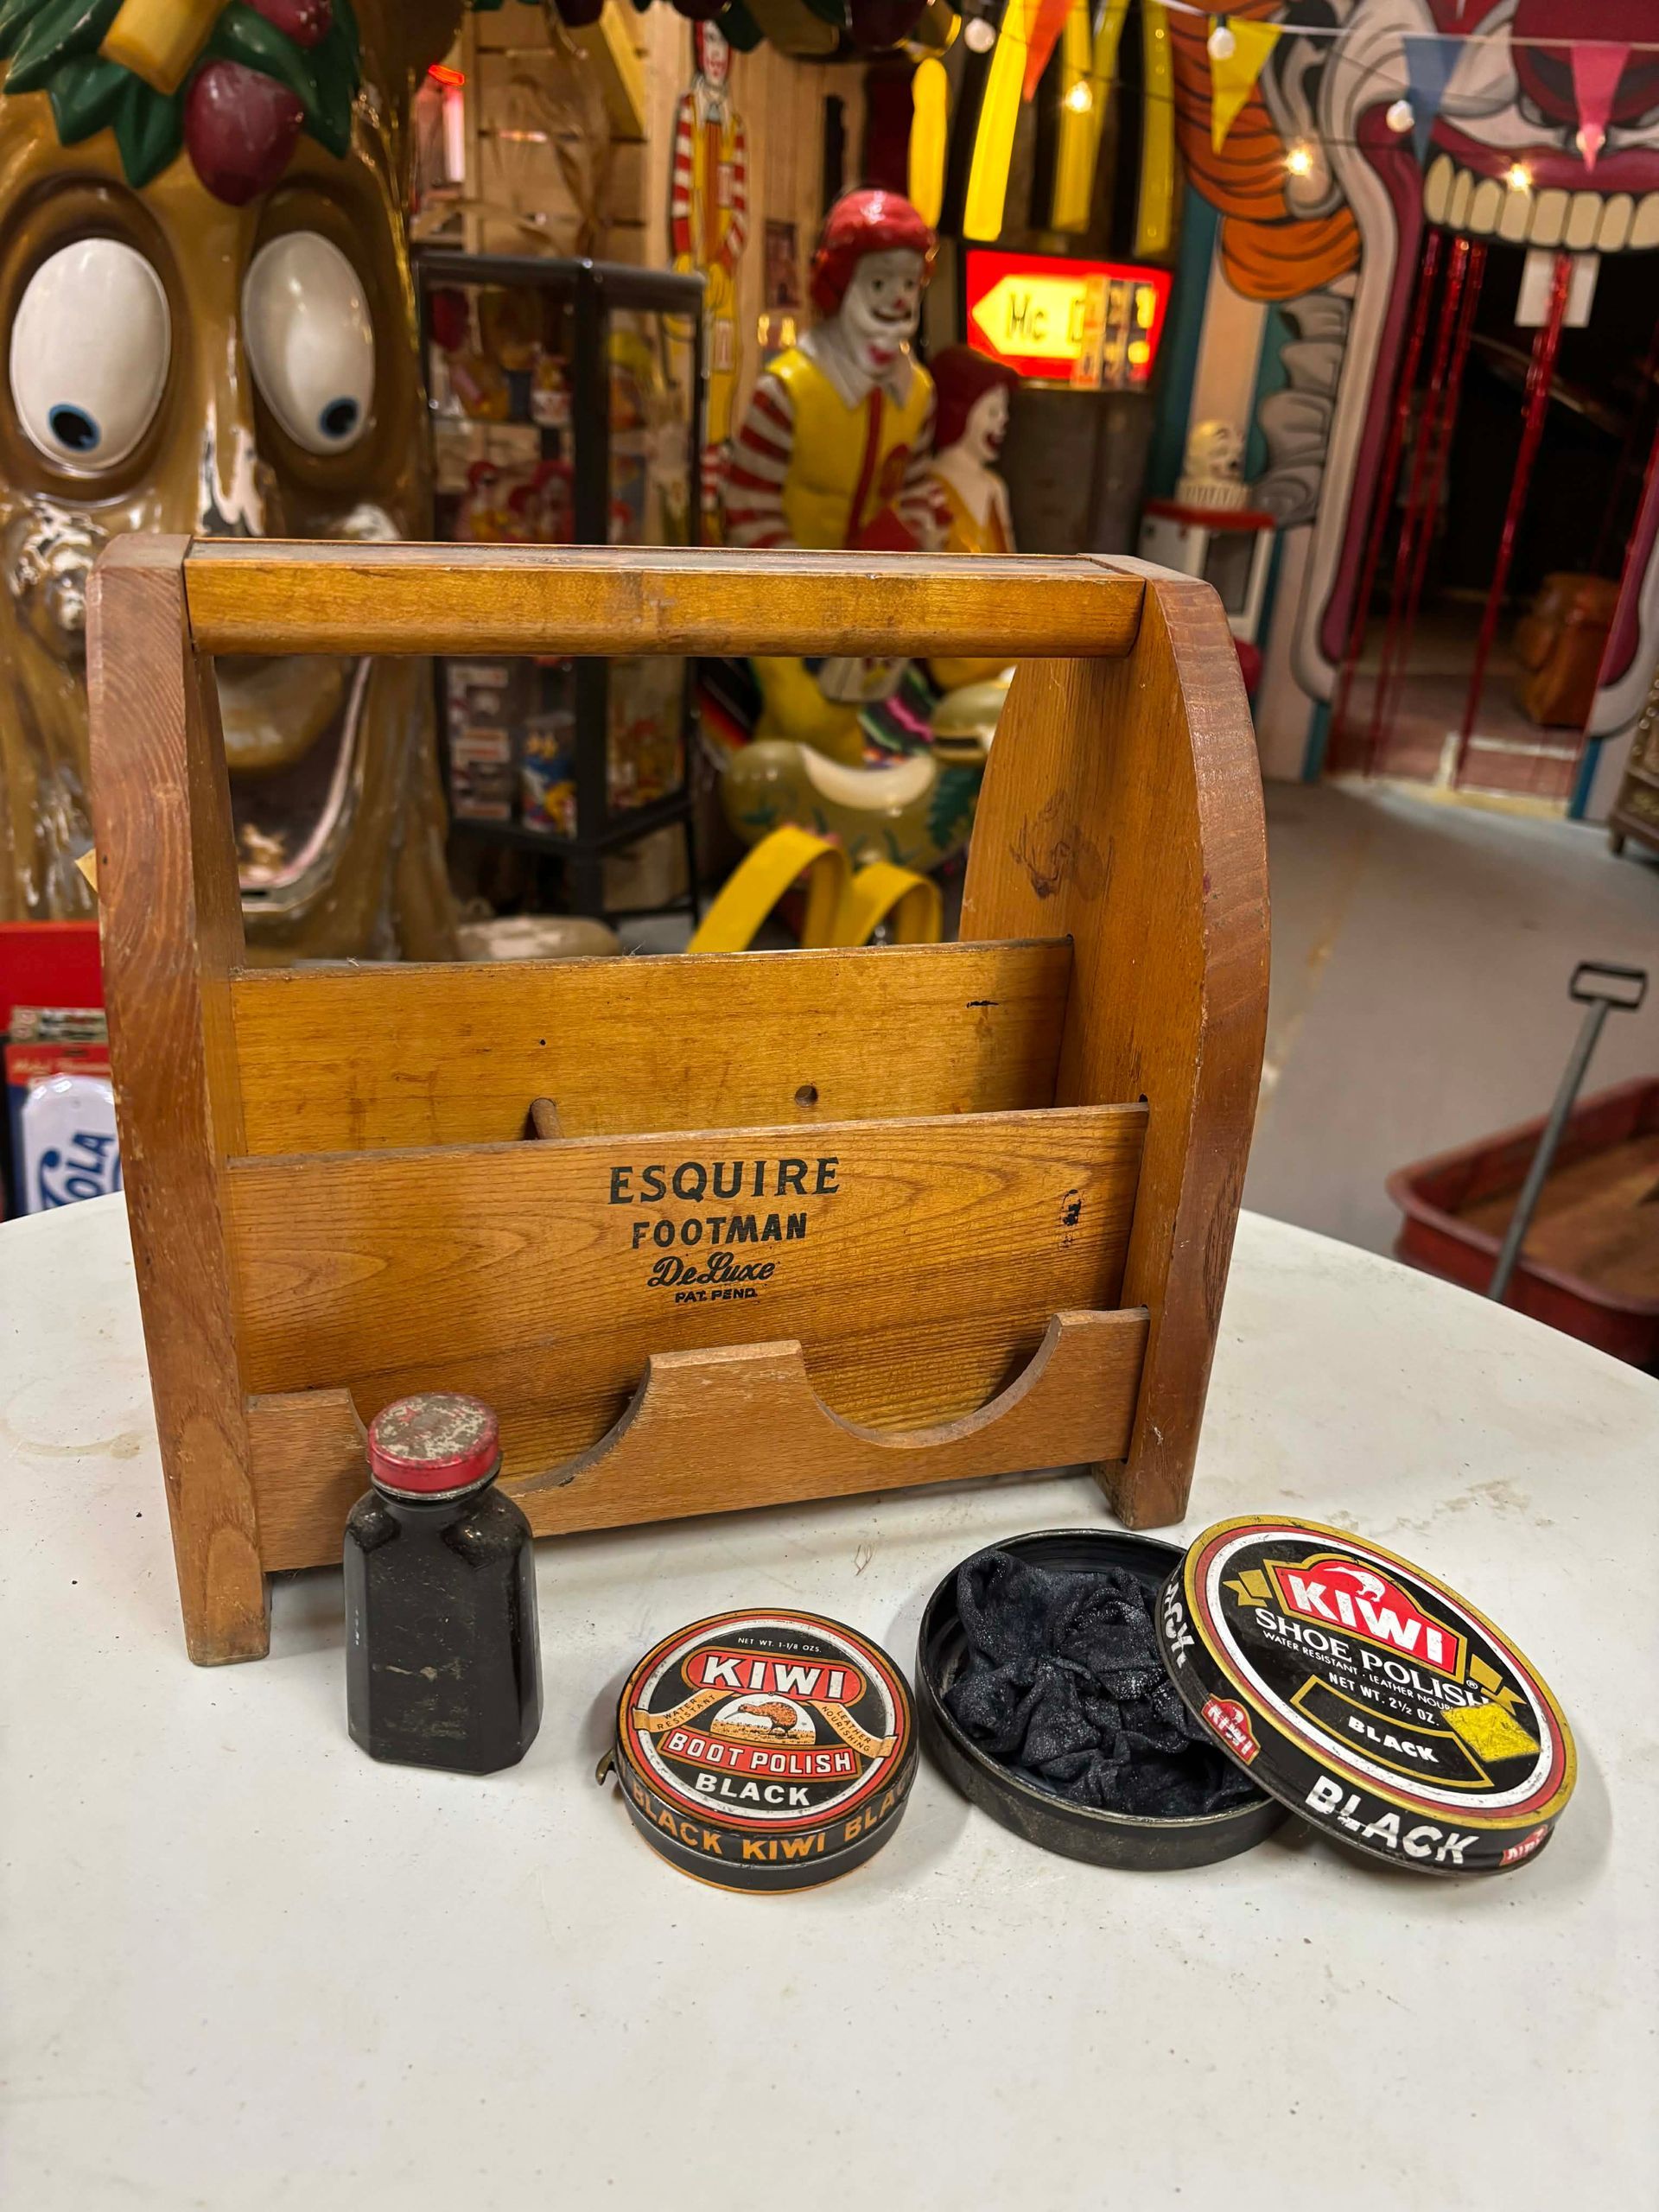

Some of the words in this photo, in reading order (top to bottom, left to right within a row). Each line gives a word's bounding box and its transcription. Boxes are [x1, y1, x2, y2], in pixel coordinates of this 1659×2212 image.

[607, 1157, 840, 1205] ESQUIRE
[632, 1212, 807, 1249] FOOTMAN
[647, 1251, 776, 1287] DeLuxe
[675, 1290, 708, 1303] PAT.
[711, 1287, 758, 1301] PEND.
[1255, 1607, 1352, 1663] SHOE
[1287, 1573, 1443, 1664] KIWI
[701, 1656, 846, 1700] KIWI
[1262, 1630, 1300, 1652] WATER
[1302, 1646, 1358, 1675] RESISTANT
[1369, 1674, 1414, 1699] LEATHER
[657, 1694, 716, 1730] RESISTANT
[663, 1698, 697, 1719] WATER
[1329, 1672, 1356, 1692] NET
[1359, 1684, 1385, 1704] WT.
[1416, 1708, 1440, 1726] OZ.
[822, 1706, 871, 1751] NOURISHING
[836, 1710, 872, 1744] LEATHER
[1207, 1704, 1253, 1756] KIWI
[1348, 1715, 1439, 1763] BLACK
[667, 1730, 745, 1767] BOOT
[750, 1749, 852, 1775] POLISH
[695, 1772, 810, 1806] BLACK
[632, 1780, 723, 1854] BLACK
[742, 1832, 826, 1860] KIWI
[1305, 1775, 1480, 1865] BLACK
